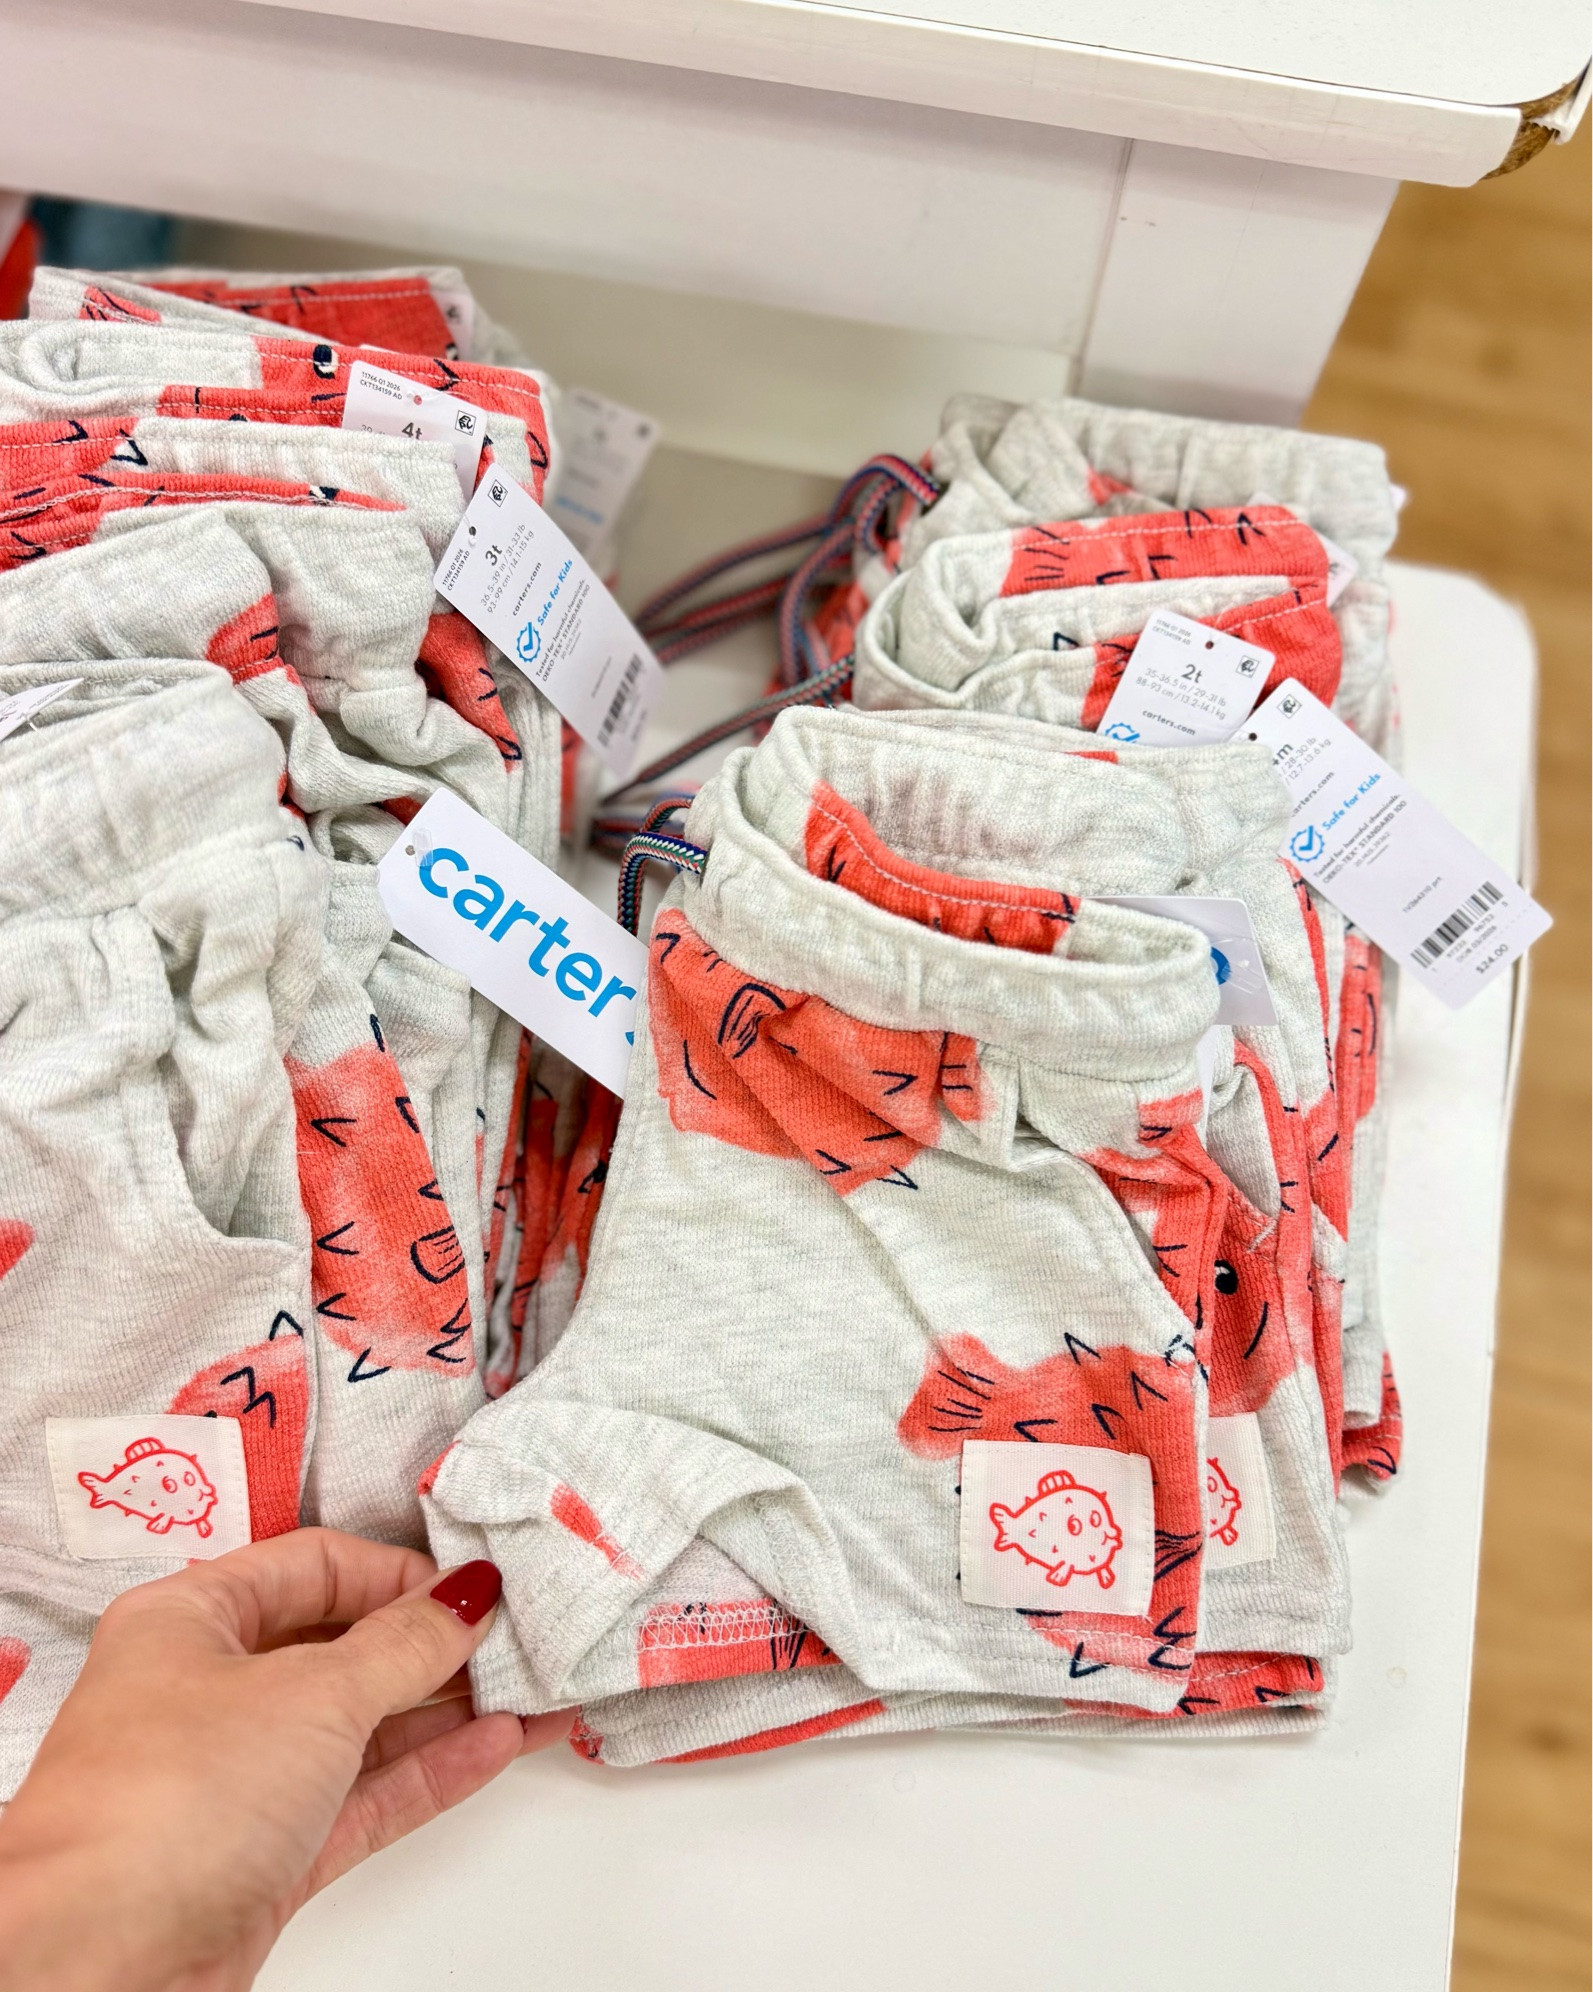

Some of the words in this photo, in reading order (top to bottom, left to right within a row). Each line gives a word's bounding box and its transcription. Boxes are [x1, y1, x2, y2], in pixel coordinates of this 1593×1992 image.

[386, 381, 401, 391] 2026
[392, 392, 403, 400] AD
[401, 422, 423, 440] 4t
[463, 550, 470, 561] AD
[480, 570, 501, 607] 36.5-39
[498, 562, 507, 572] in
[505, 532, 521, 557] 31-33
[516, 524, 526, 534] lb
[485, 544, 503, 566] 3t
[486, 586, 503, 614] 93-99
[502, 574, 511, 588] cm
[510, 540, 528, 569] 14.1-15
[524, 530, 534, 542] kg
[512, 562, 542, 616] carters.com
[537, 601, 552, 626] Safe
[549, 583, 560, 600] for
[557, 559, 573, 583] Kids
[562, 598, 583, 640] STANDARD
[535, 652, 550, 677] Tested
[546, 642, 555, 654] for
[552, 612, 569, 642] harmful
[1145, 667, 1179, 687] 35-36.5
[1178, 682, 1188, 691] in
[1193, 687, 1218, 703] 29-31
[1217, 697, 1226, 707] lb
[1181, 663, 1202, 684] 2t
[1135, 676, 1162, 692] 88-93
[1161, 689, 1174, 698] cm
[1215, 708, 1226, 721] kg
[1142, 710, 1196, 736] carters.com
[1284, 744, 1308, 769] 28-30
[1306, 737, 1317, 746] lb
[1287, 747, 1321, 780] 12.7-13.6
[1318, 738, 1332, 749] kg
[1322, 809, 1346, 830] Safe
[1343, 794, 1359, 809] for
[1357, 774, 1381, 794] Kids
[1313, 856, 1336, 877] Tested
[1333, 848, 1344, 858] for
[1342, 822, 1369, 849] harmful
[1368, 794, 1400, 824] chemicals.
[1358, 812, 1395, 848] STANDARD
[1393, 800, 1407, 813] 100
[419, 847, 637, 1047] carter
[1475, 943, 1509, 974] $24.00
